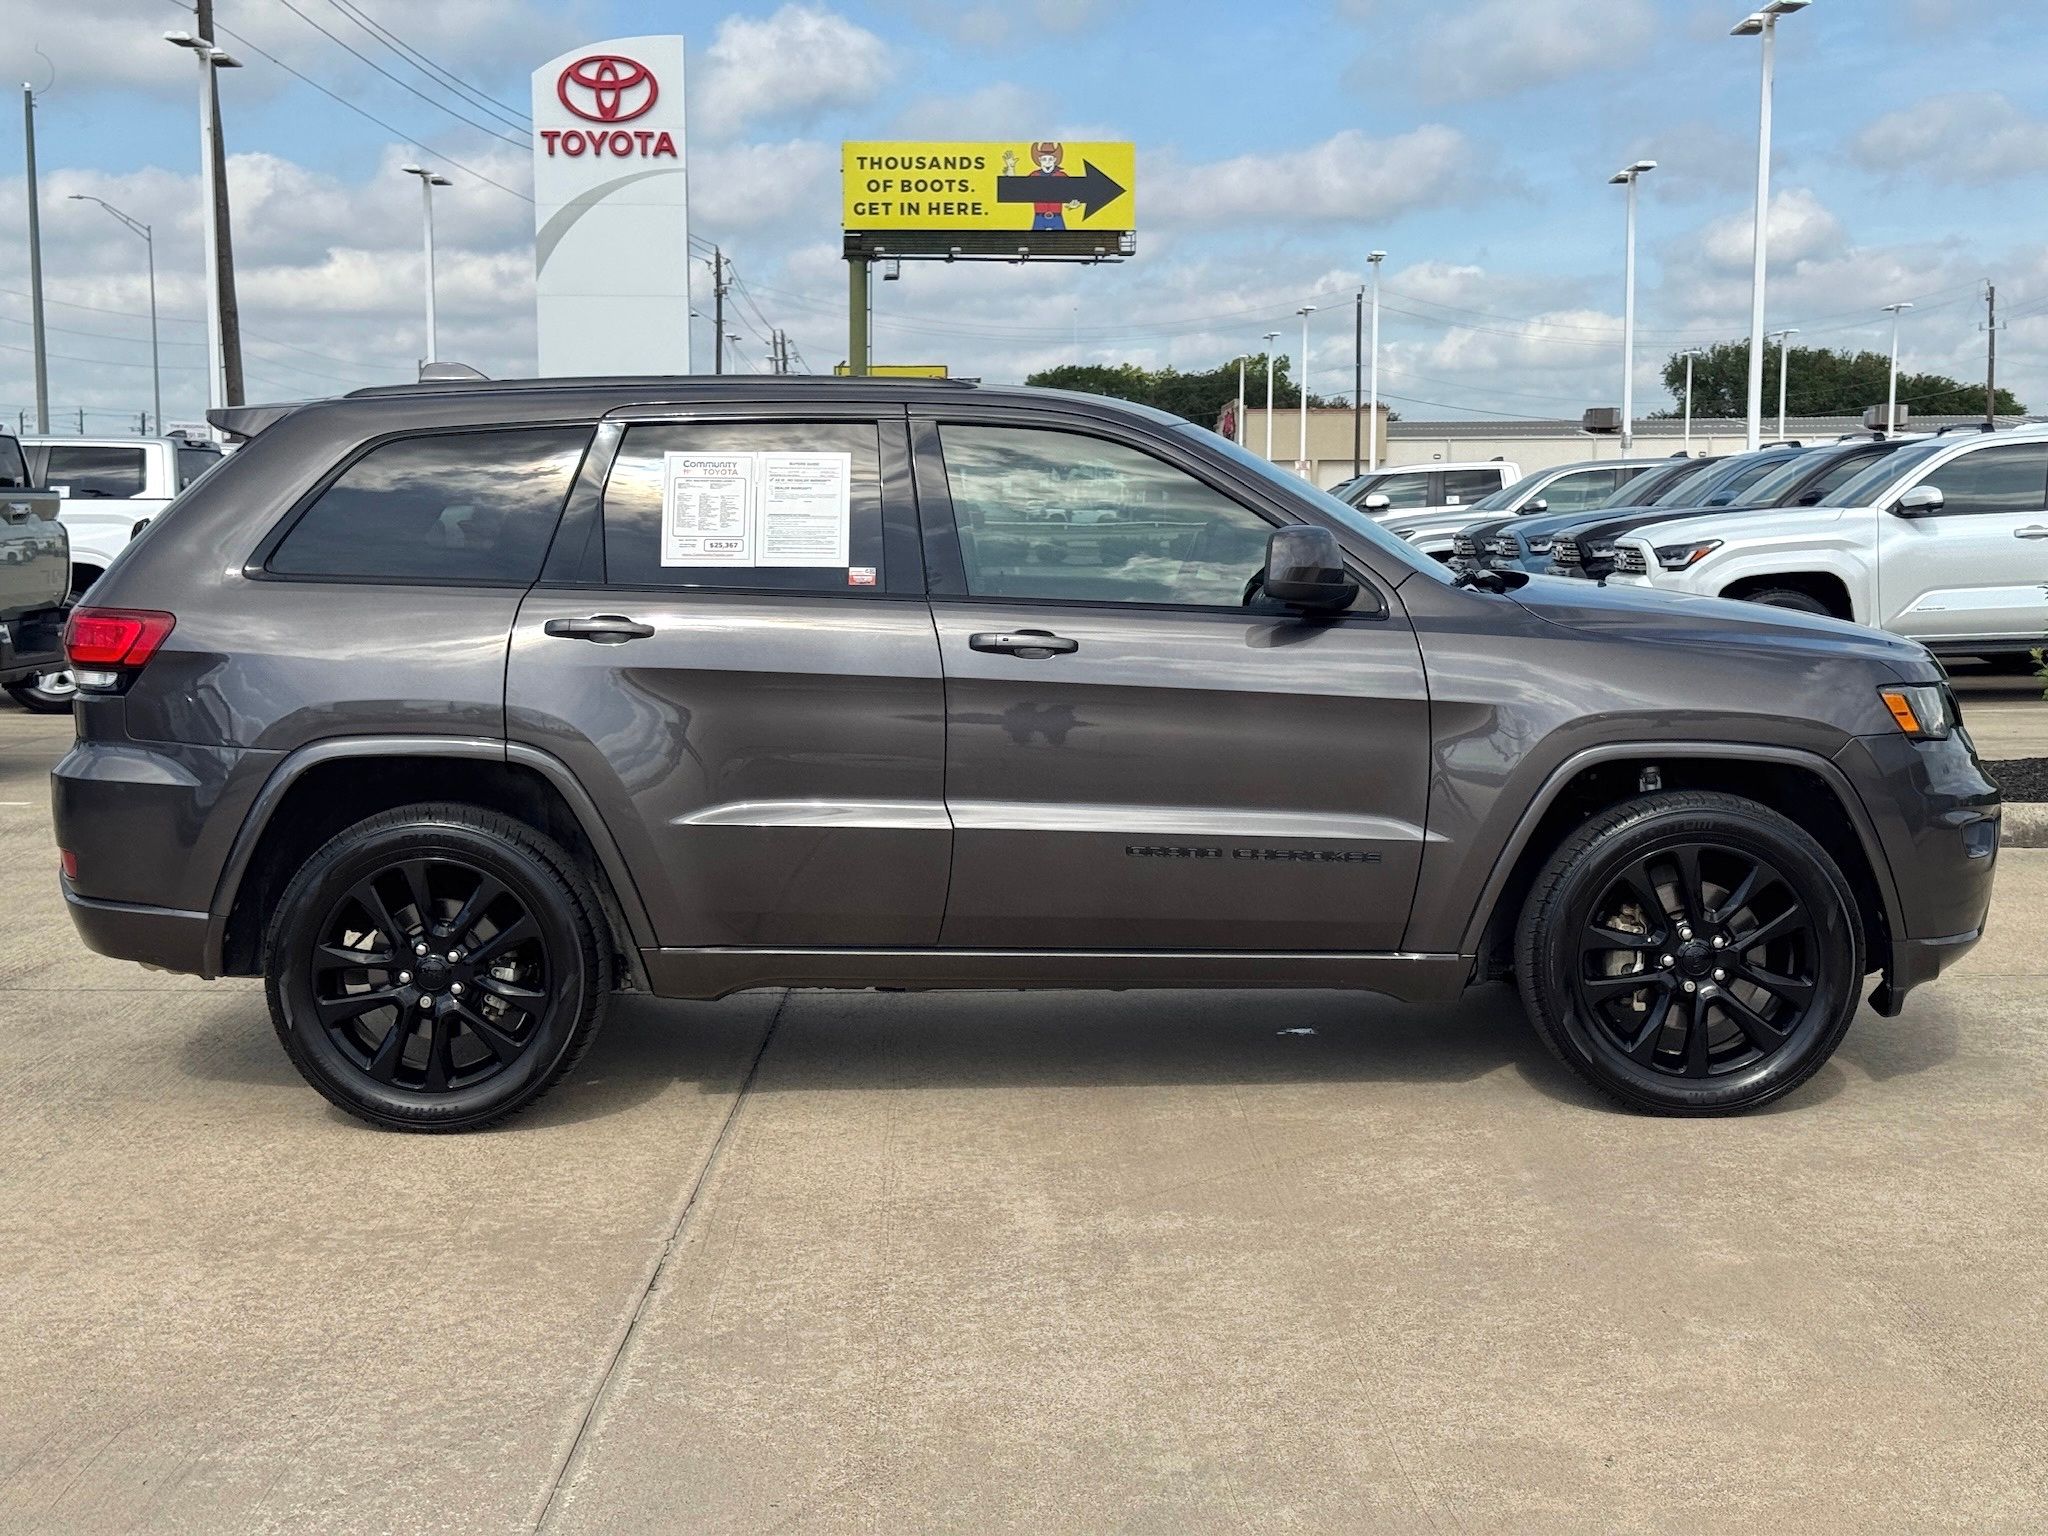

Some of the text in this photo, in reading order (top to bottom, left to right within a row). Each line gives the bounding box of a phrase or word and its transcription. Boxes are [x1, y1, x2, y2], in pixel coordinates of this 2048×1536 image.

[540, 130, 677, 158] TOYOTA
[856, 156, 985, 170] THOUSANDS
[867, 179, 975, 193] OF BOOTS.
[853, 202, 989, 216] GET IN HERE.
